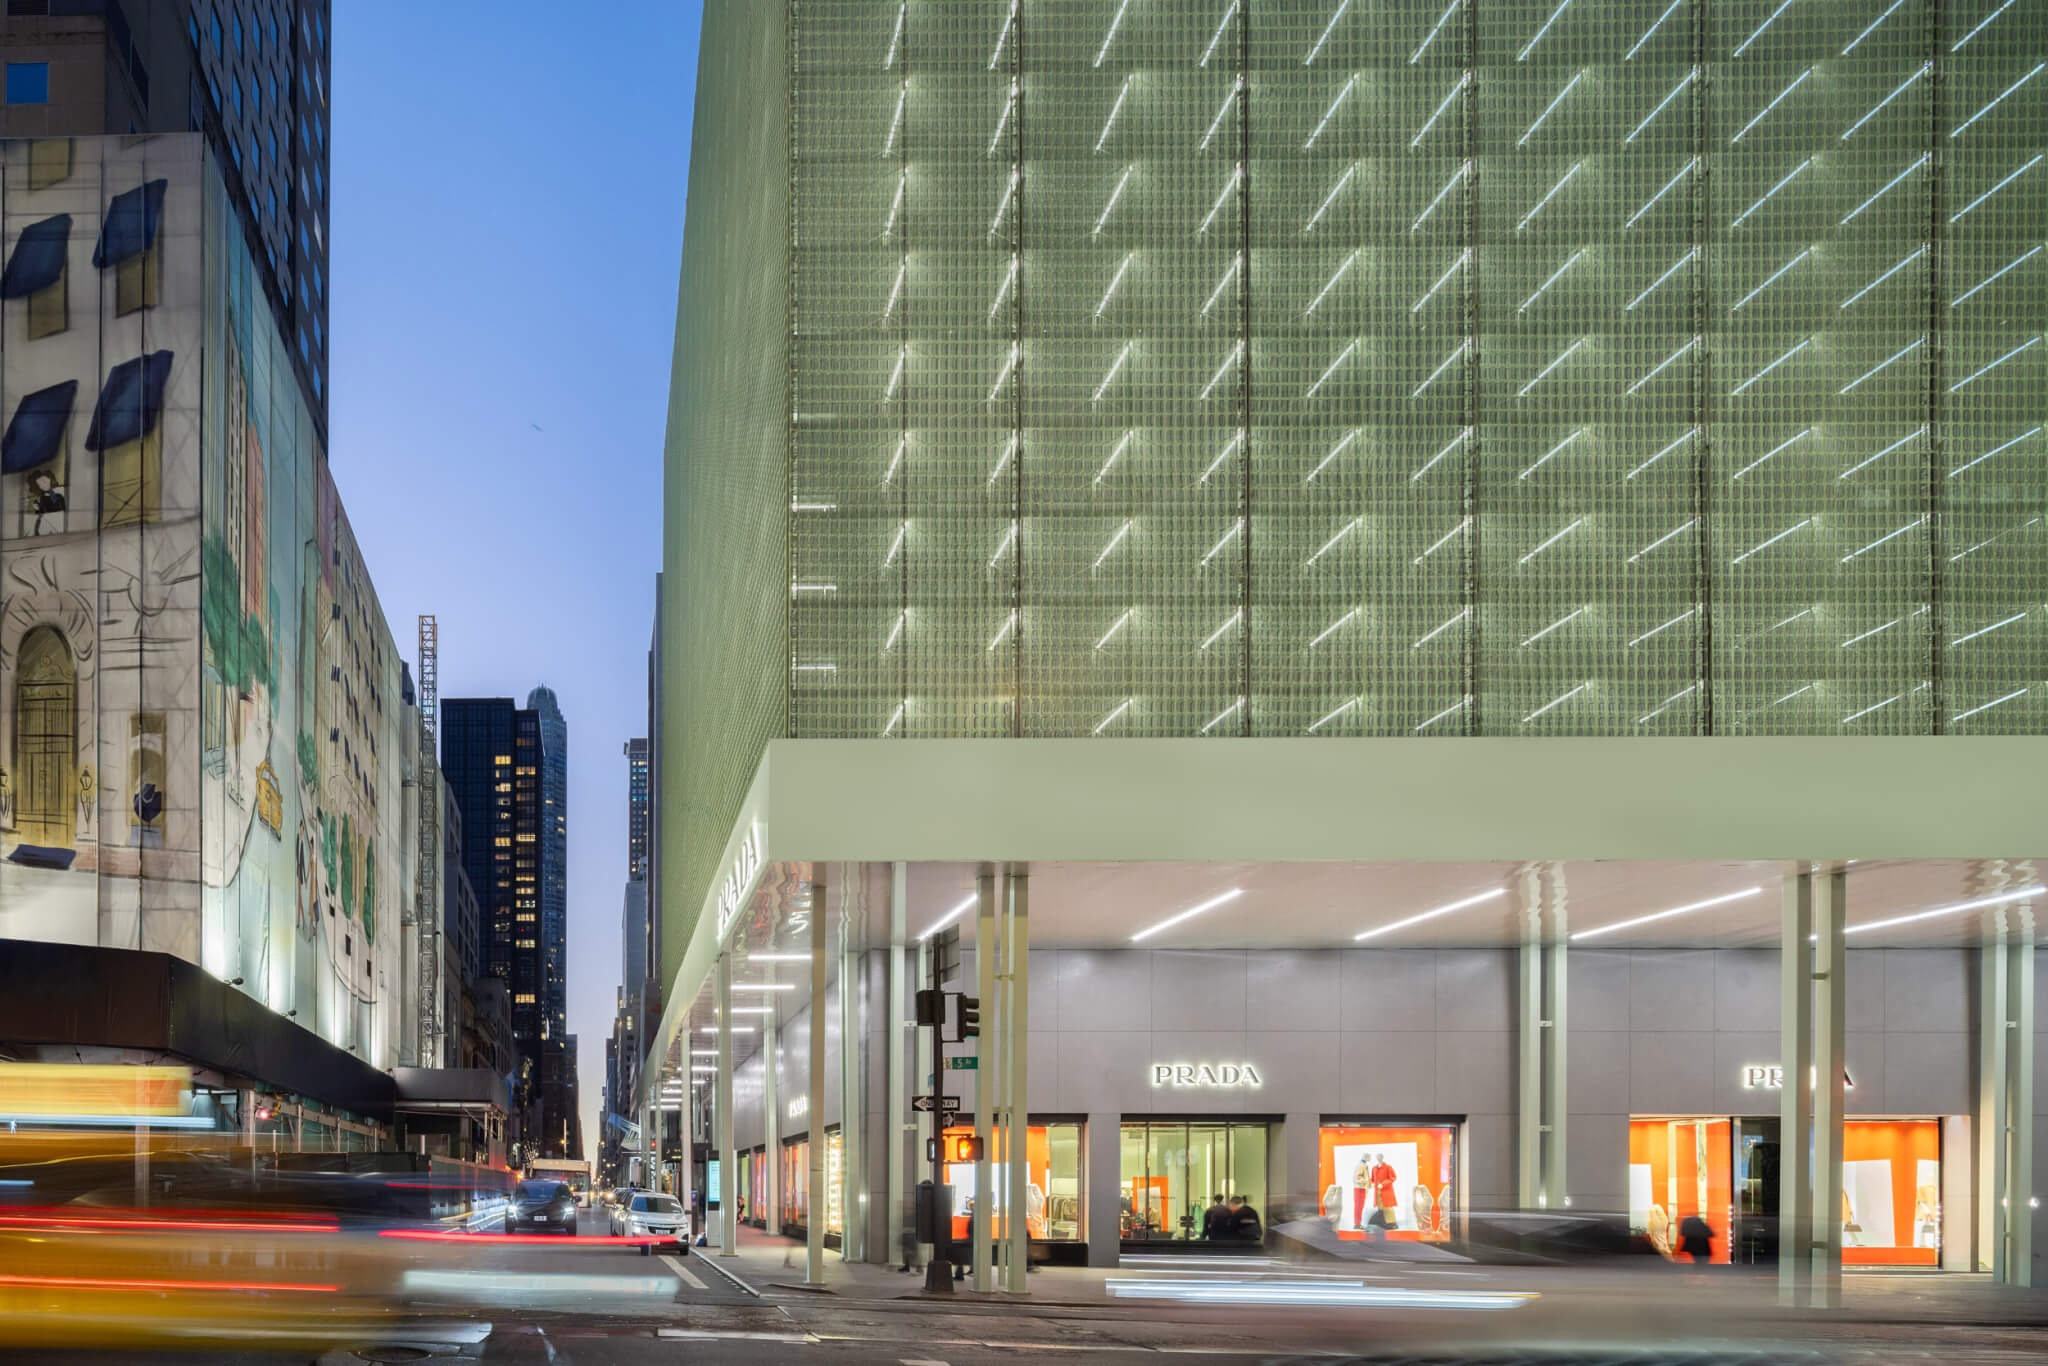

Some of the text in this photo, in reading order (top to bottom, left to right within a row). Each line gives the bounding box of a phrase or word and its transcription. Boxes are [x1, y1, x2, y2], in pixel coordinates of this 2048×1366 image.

[718, 818, 761, 940] PRADA
[957, 1058, 963, 1069] 5
[1153, 1064, 1262, 1086] PRADA
[1743, 1065, 1855, 1089] PRA
